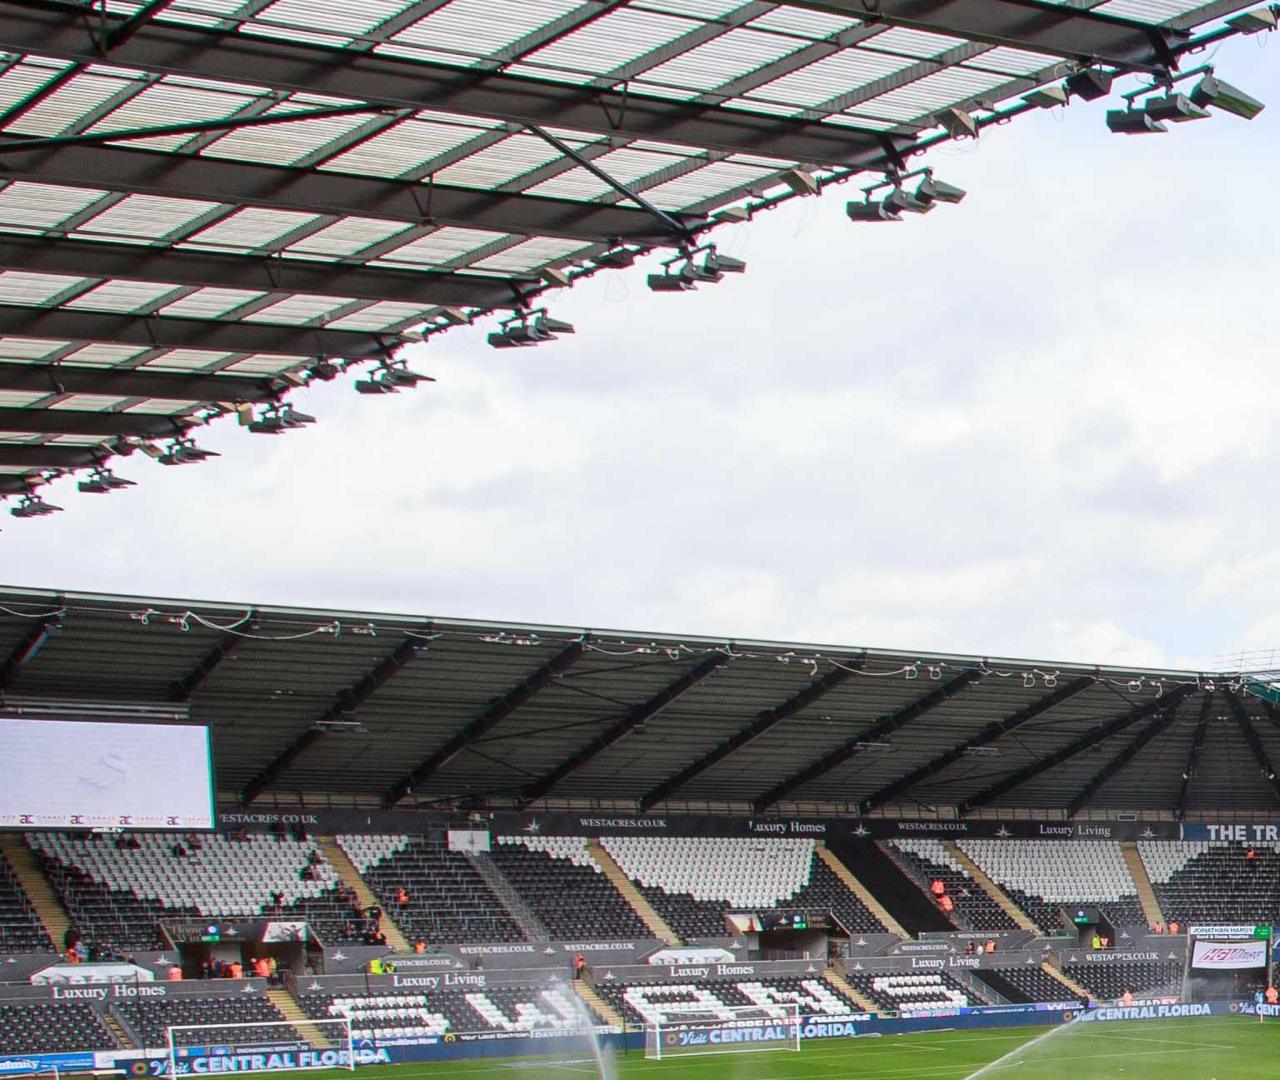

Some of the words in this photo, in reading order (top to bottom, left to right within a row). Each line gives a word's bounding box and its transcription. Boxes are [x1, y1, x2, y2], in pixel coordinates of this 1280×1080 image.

[790, 821, 826, 833] Homes
[1040, 824, 1074, 838] Luxury
[1078, 824, 1111, 838] Living
[1207, 825, 1246, 840] THE
[912, 957, 945, 969] Luxury
[949, 955, 980, 968] Living
[670, 966, 709, 978] Luxury
[717, 964, 754, 976] Homes
[393, 974, 440, 989] Luxury
[444, 973, 486, 988] Living
[53, 986, 108, 1001] Luxury
[113, 984, 166, 997] Homes
[1096, 1005, 1158, 1020] CENTRAL
[1159, 1003, 1211, 1017] FLORIDA
[709, 1026, 785, 1042] CENTRAL
[790, 1023, 855, 1038] FLORIDA
[192, 1051, 297, 1073] CENTRAL
[299, 1048, 391, 1067] FLORIDA
